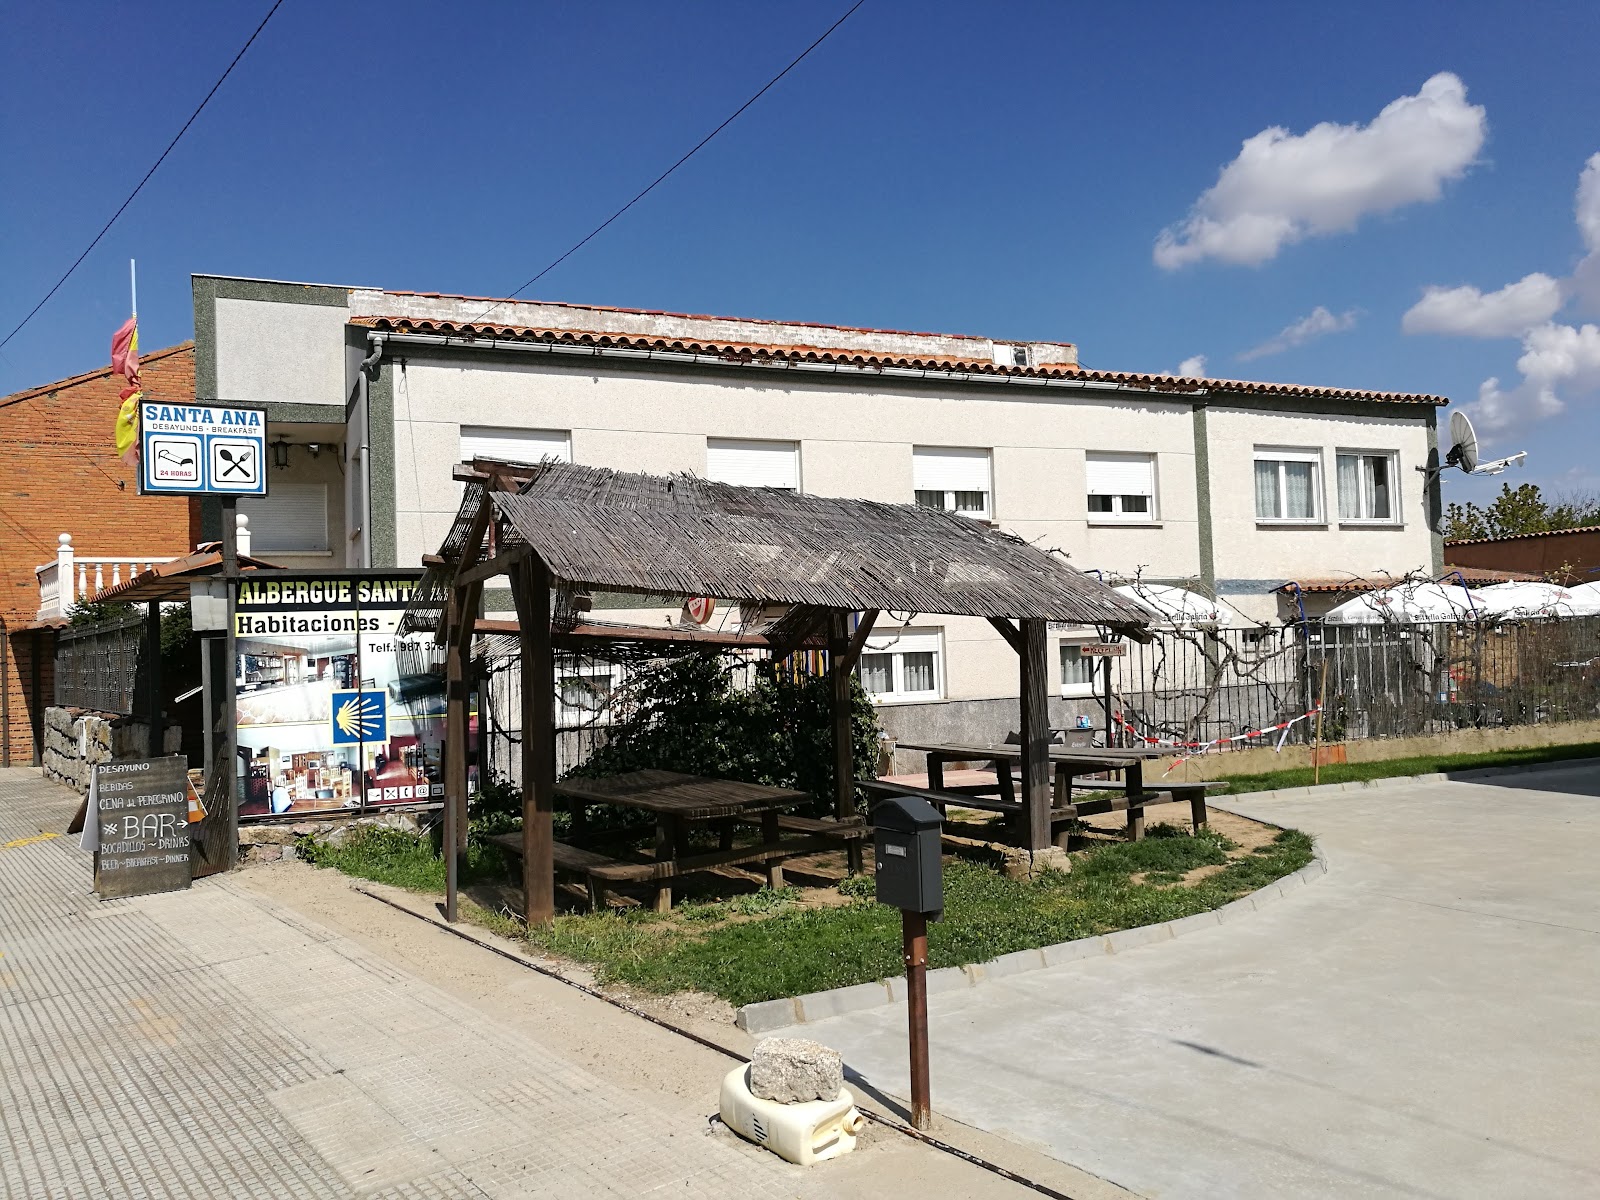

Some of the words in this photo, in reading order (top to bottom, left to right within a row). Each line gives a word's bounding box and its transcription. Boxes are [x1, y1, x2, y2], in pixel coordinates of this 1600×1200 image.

[145, 405, 215, 424] SANTA
[221, 410, 261, 427] ANA
[152, 423, 204, 432] DESAYUNOS
[212, 426, 257, 434] BREAKFAST
[238, 580, 352, 605] ALBERGUE
[237, 614, 380, 634] Habitaciones
[400, 642, 421, 652] 987
[98, 762, 150, 774] DESAYUNO
[98, 781, 134, 793] BEBIDAS
[99, 797, 124, 810] CENA
[136, 791, 184, 807] PEREGRINO
[122, 813, 177, 840] BAR
[101, 840, 146, 855] BOCADILLOS
[158, 836, 190, 850] DRINKS
[101, 859, 120, 871] BEER
[126, 856, 159, 868] BREAKFAST
[165, 853, 189, 864] DINNER
